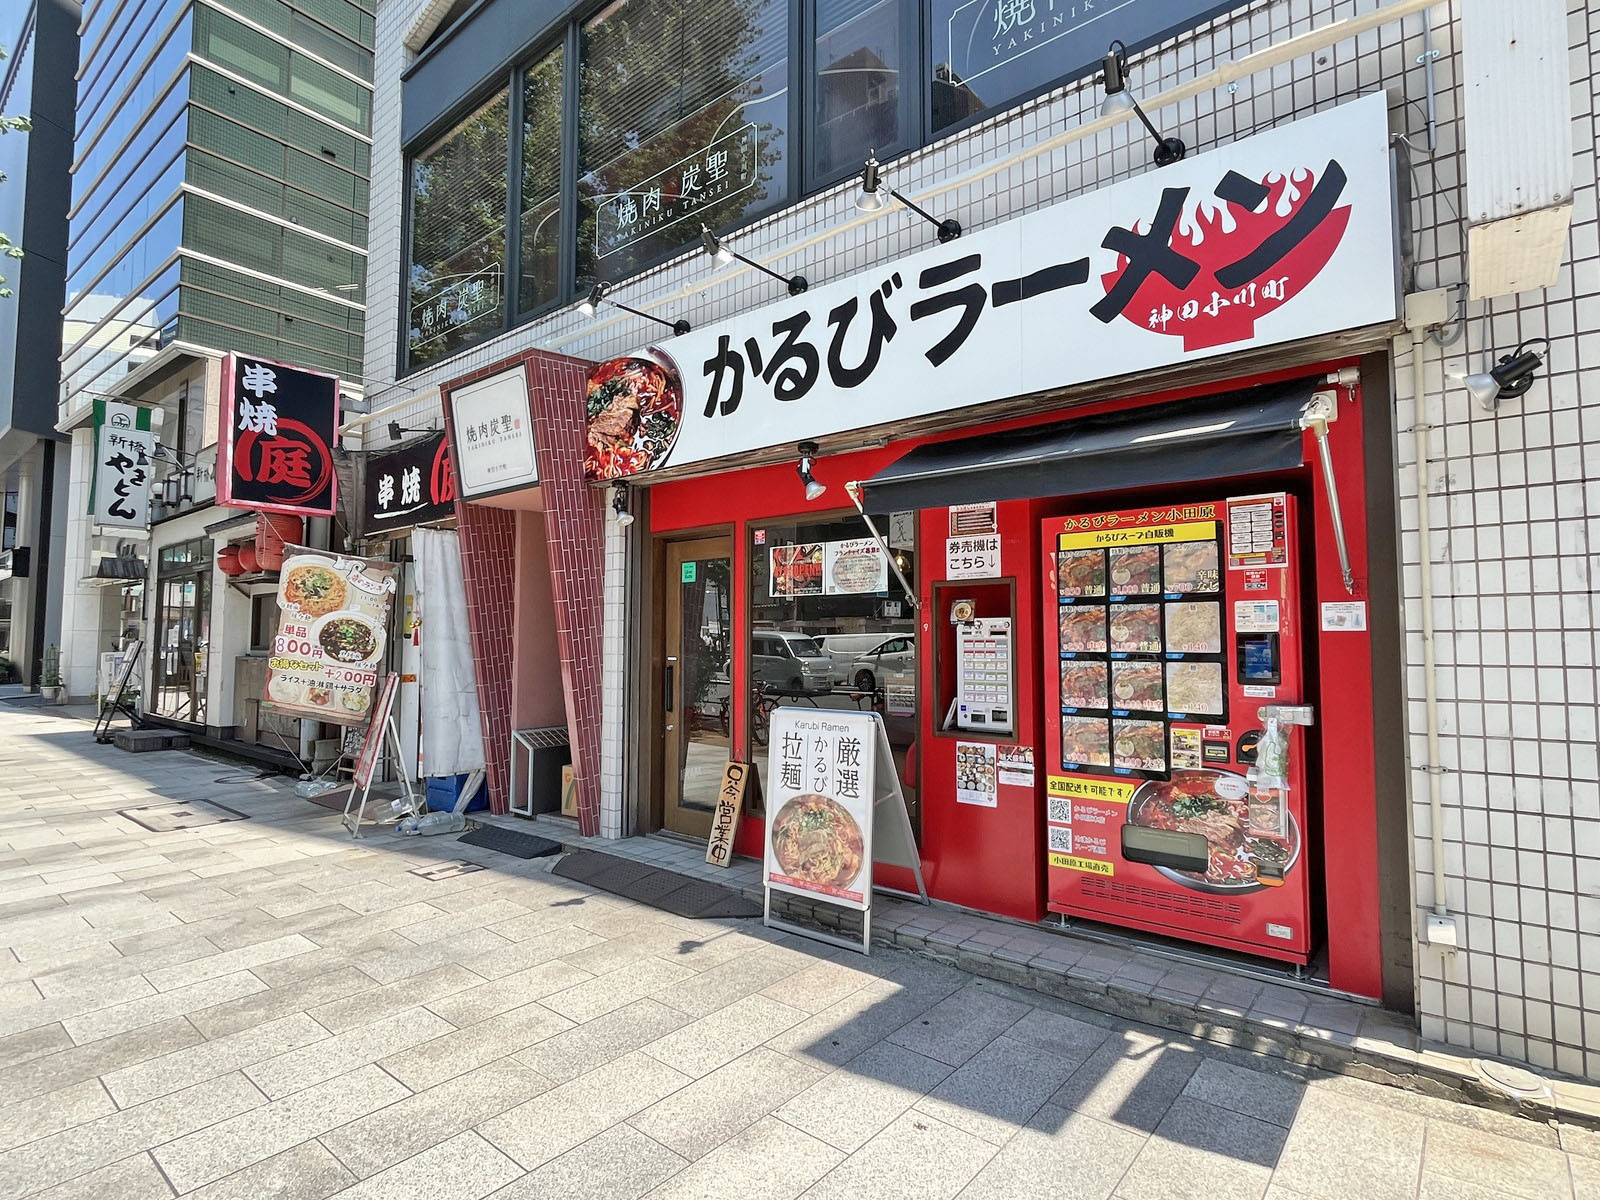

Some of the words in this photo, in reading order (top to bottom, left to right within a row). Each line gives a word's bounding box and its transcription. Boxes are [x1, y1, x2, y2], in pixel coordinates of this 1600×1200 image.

[992, 0, 1054, 40] 焼
[993, 0, 1095, 56] YAKINIK
[617, 187, 661, 230] 焼肉
[680, 150, 729, 199] 炭聖
[683, 180, 729, 209] TANSEI
[703, 159, 1347, 418] かるびラーメン
[1149, 276, 1289, 331] 神田小川町
[421, 299, 447, 330] 焼肉
[238, 363, 278, 436] 串焼
[467, 414, 513, 443] 焼肉炭聖
[256, 435, 312, 488] 庭
[105, 451, 147, 520] やきとん
[378, 465, 421, 509] 串焼
[1064, 505, 1215, 531] かるびラーメン小田原
[1096, 528, 1174, 543] かるびスープ自販機
[949, 538, 998, 555] 券売機は
[950, 556, 985, 570] こちら
[277, 638, 323, 659] 800円
[284, 625, 307, 638] 単品
[270, 658, 324, 671] お得なセット
[795, 720, 819, 730] Karubi
[822, 721, 849, 732] Ramen
[814, 736, 828, 793] かるび
[836, 736, 861, 799] 厳選
[711, 765, 743, 863] 只今営業中
